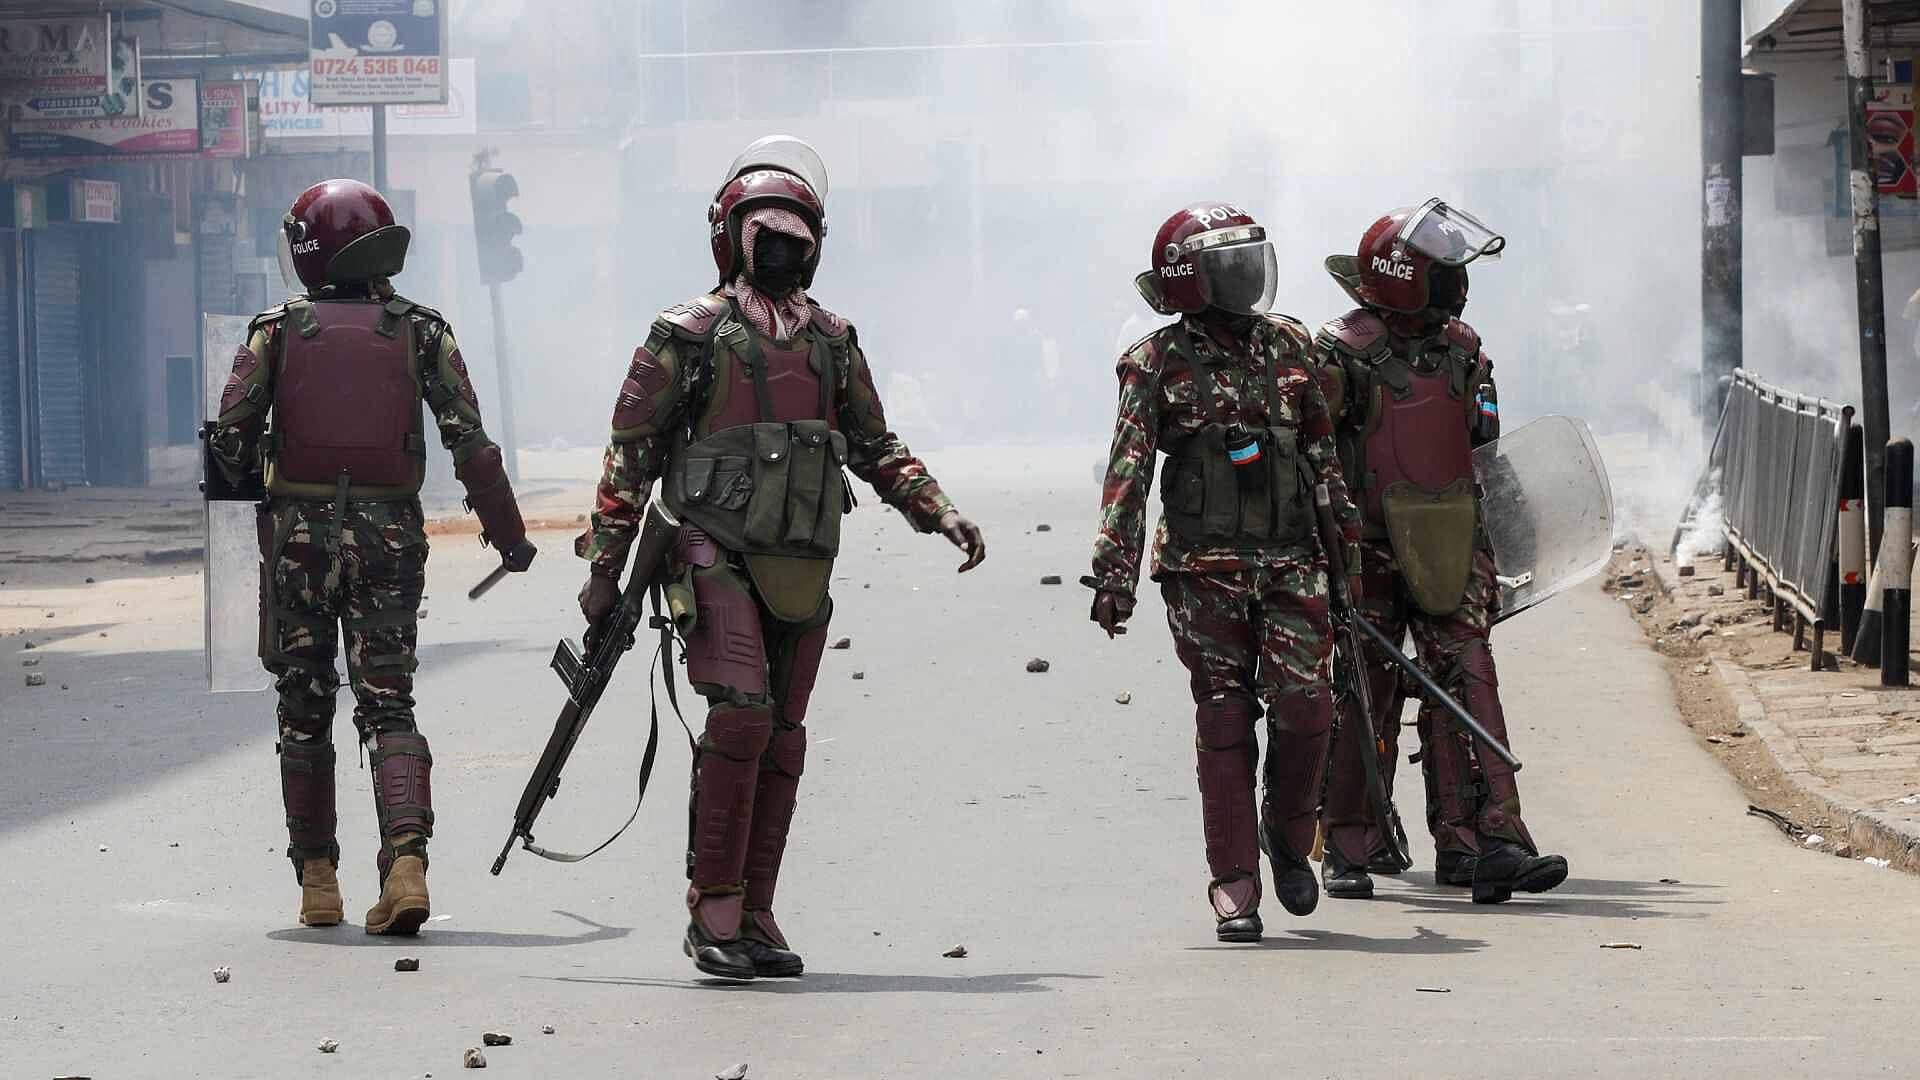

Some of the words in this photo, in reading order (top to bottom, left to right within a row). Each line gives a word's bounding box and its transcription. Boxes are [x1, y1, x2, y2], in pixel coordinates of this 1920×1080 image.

[313, 58, 358, 75] 0724
[364, 58, 397, 75] 536
[403, 58, 439, 75] 048
[109, 115, 174, 130] Cookies
[292, 239, 320, 256] POLICE
[1160, 262, 1194, 279] POLICE
[1371, 255, 1415, 281] POLICE
